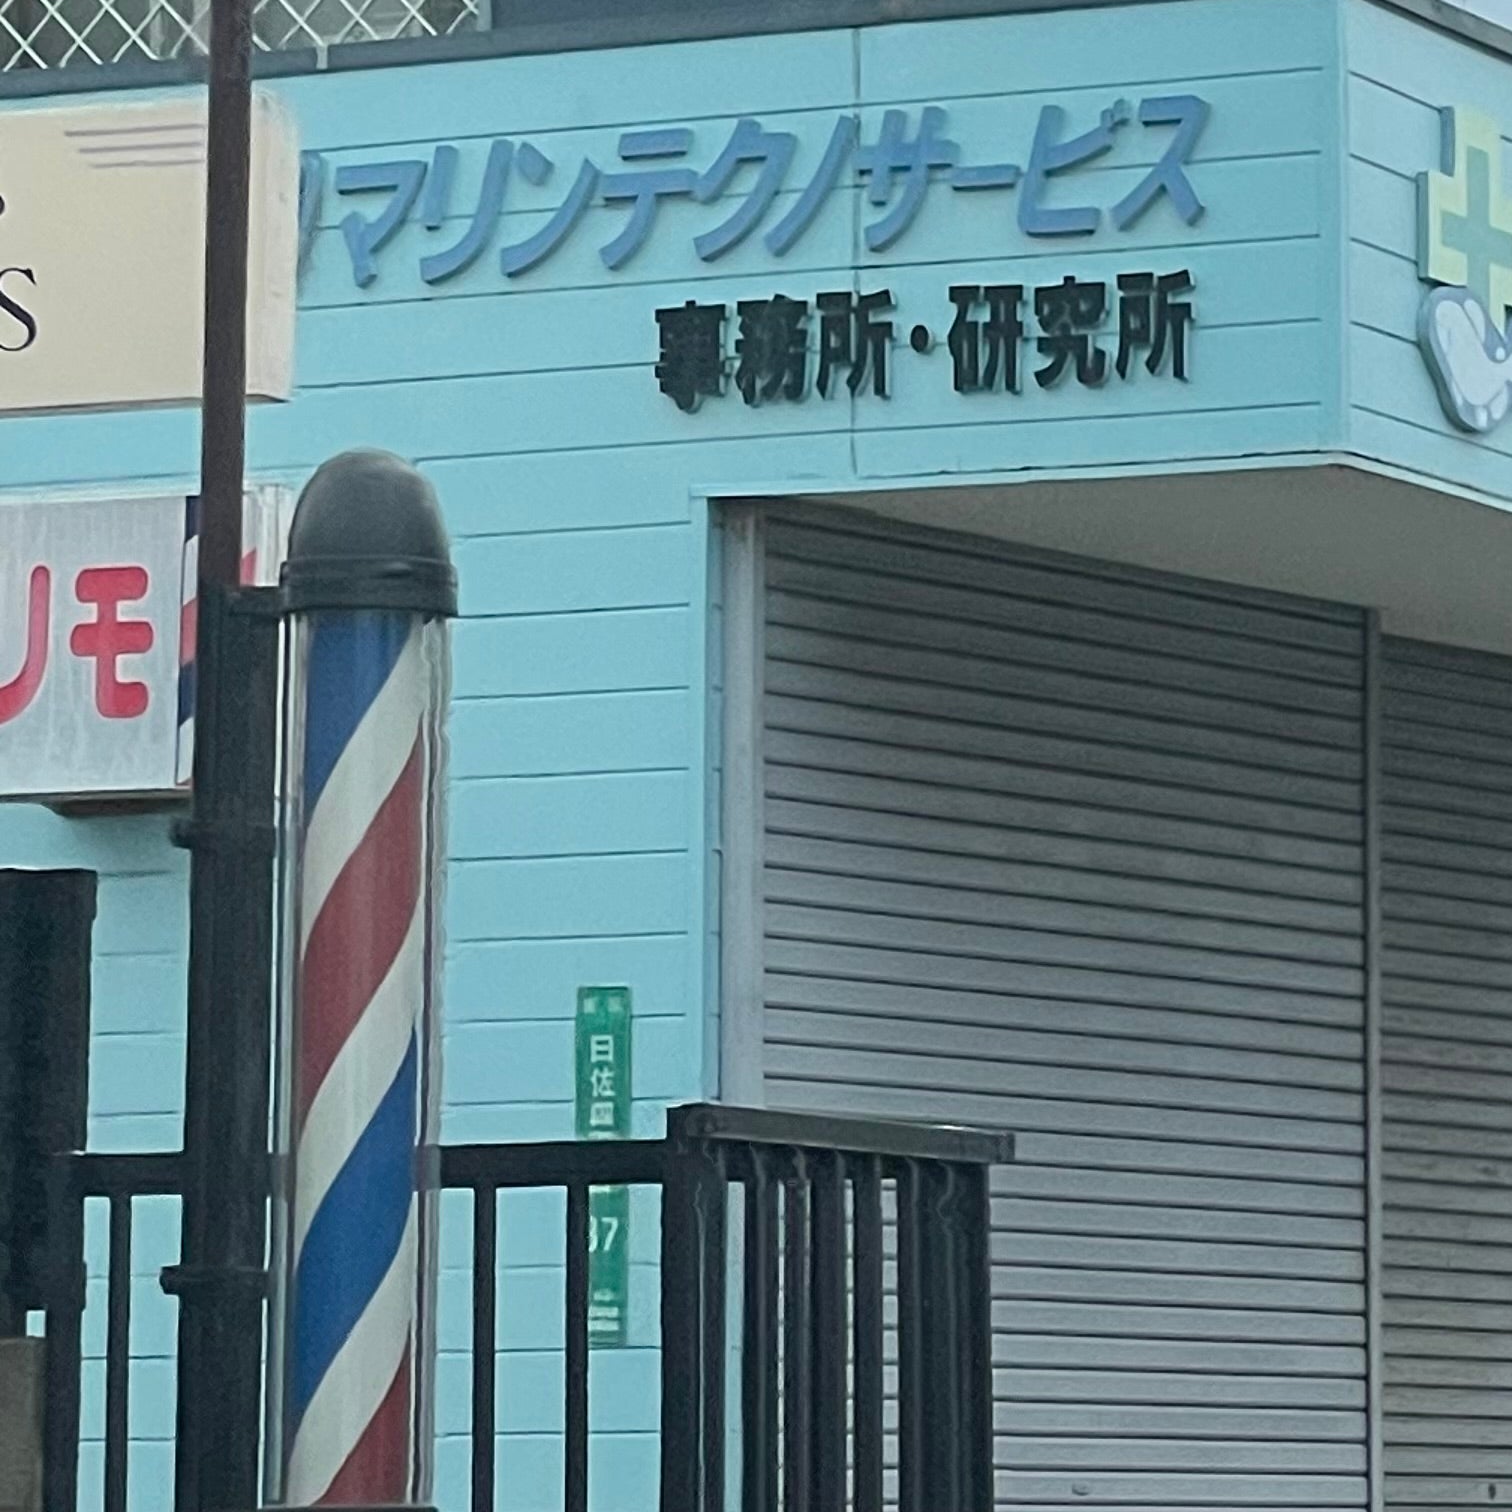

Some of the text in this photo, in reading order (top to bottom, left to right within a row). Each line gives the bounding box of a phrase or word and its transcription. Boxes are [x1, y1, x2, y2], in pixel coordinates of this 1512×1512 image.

[298, 95, 1209, 286] マリンテクノサービス
[655, 269, 1195, 414] 事務所・研究所
